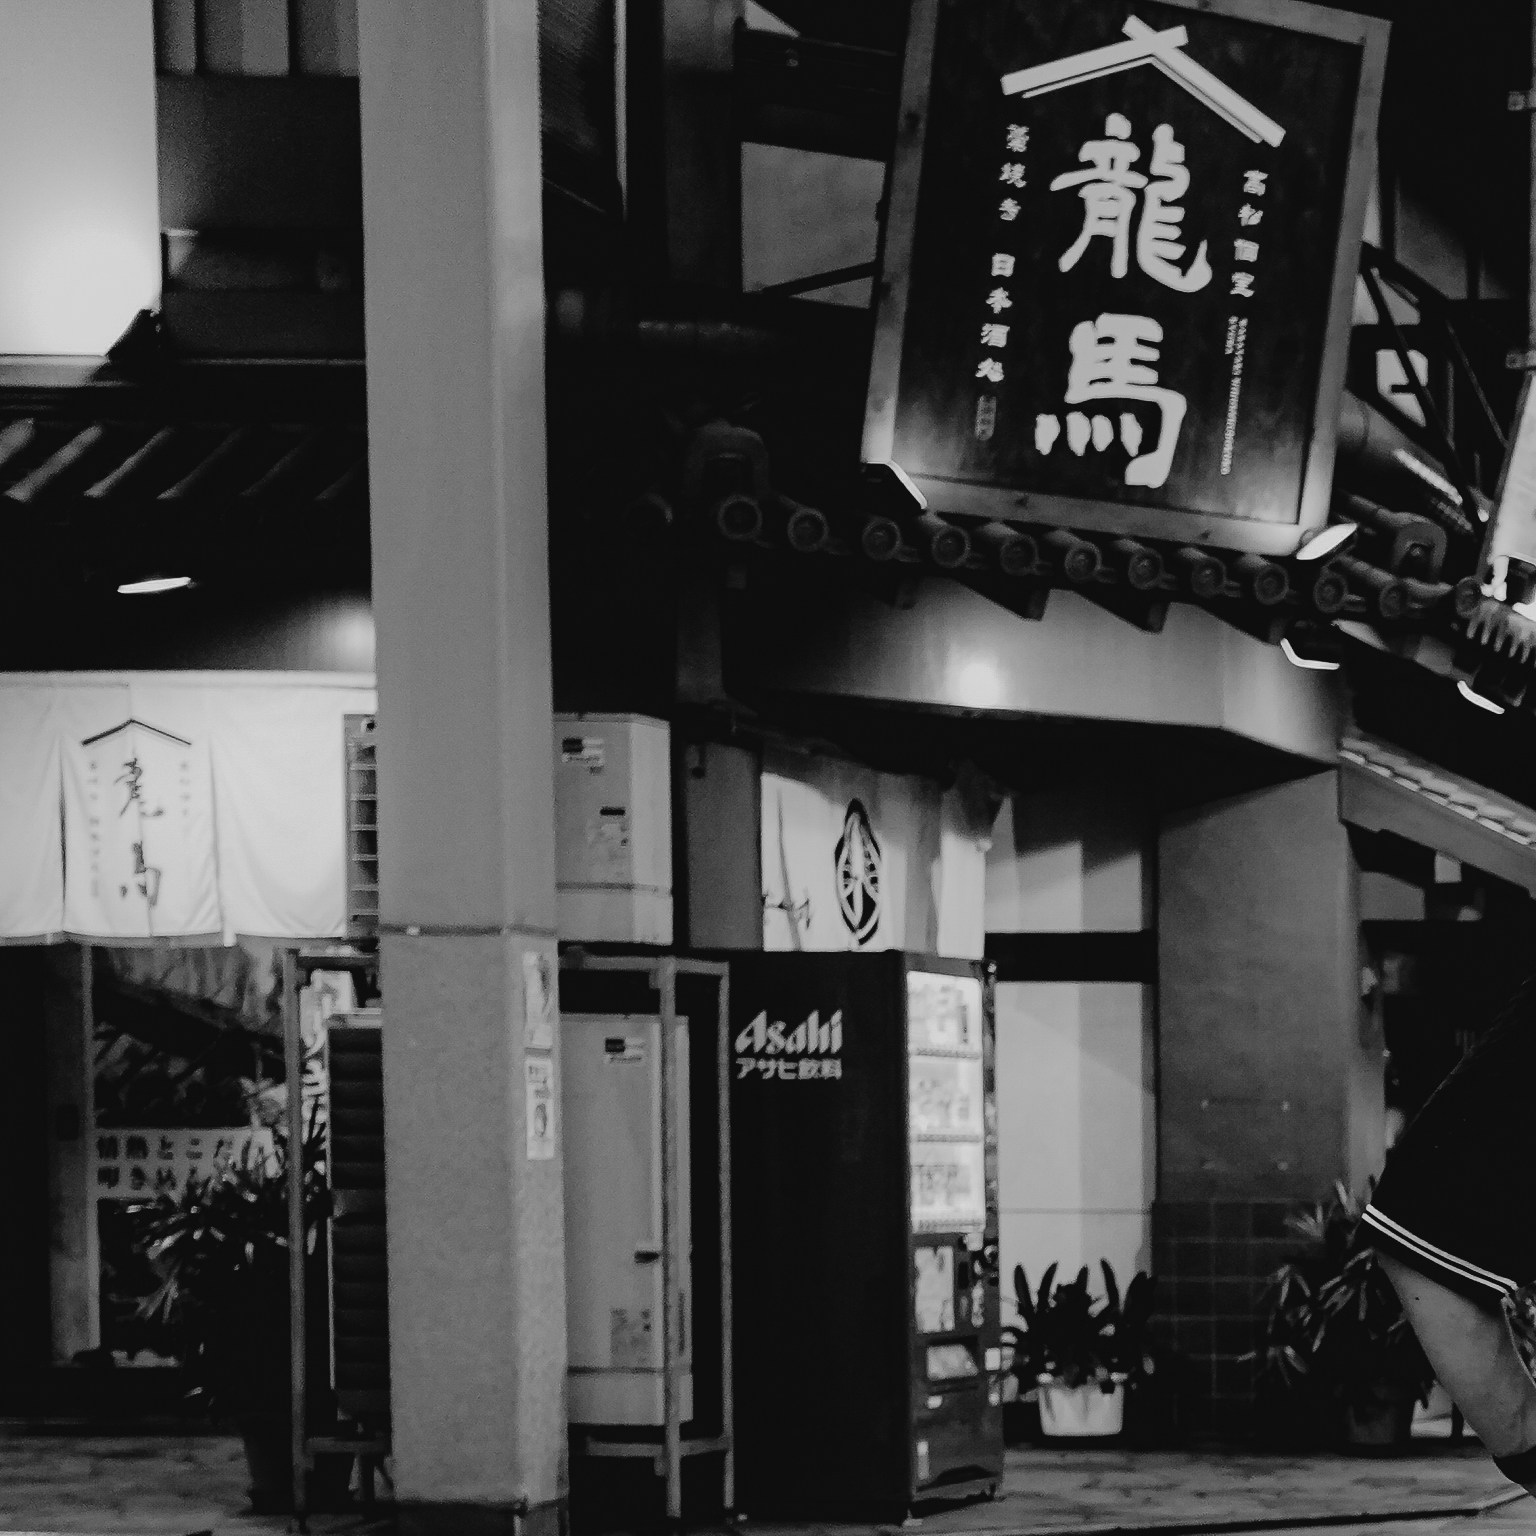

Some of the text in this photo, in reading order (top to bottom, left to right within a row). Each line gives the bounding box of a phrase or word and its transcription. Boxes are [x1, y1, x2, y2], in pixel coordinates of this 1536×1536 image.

[1034, 112, 1213, 488] 龍馬
[735, 1009, 843, 1054] Asahi
[735, 1057, 843, 1080] アサヒ飲料
